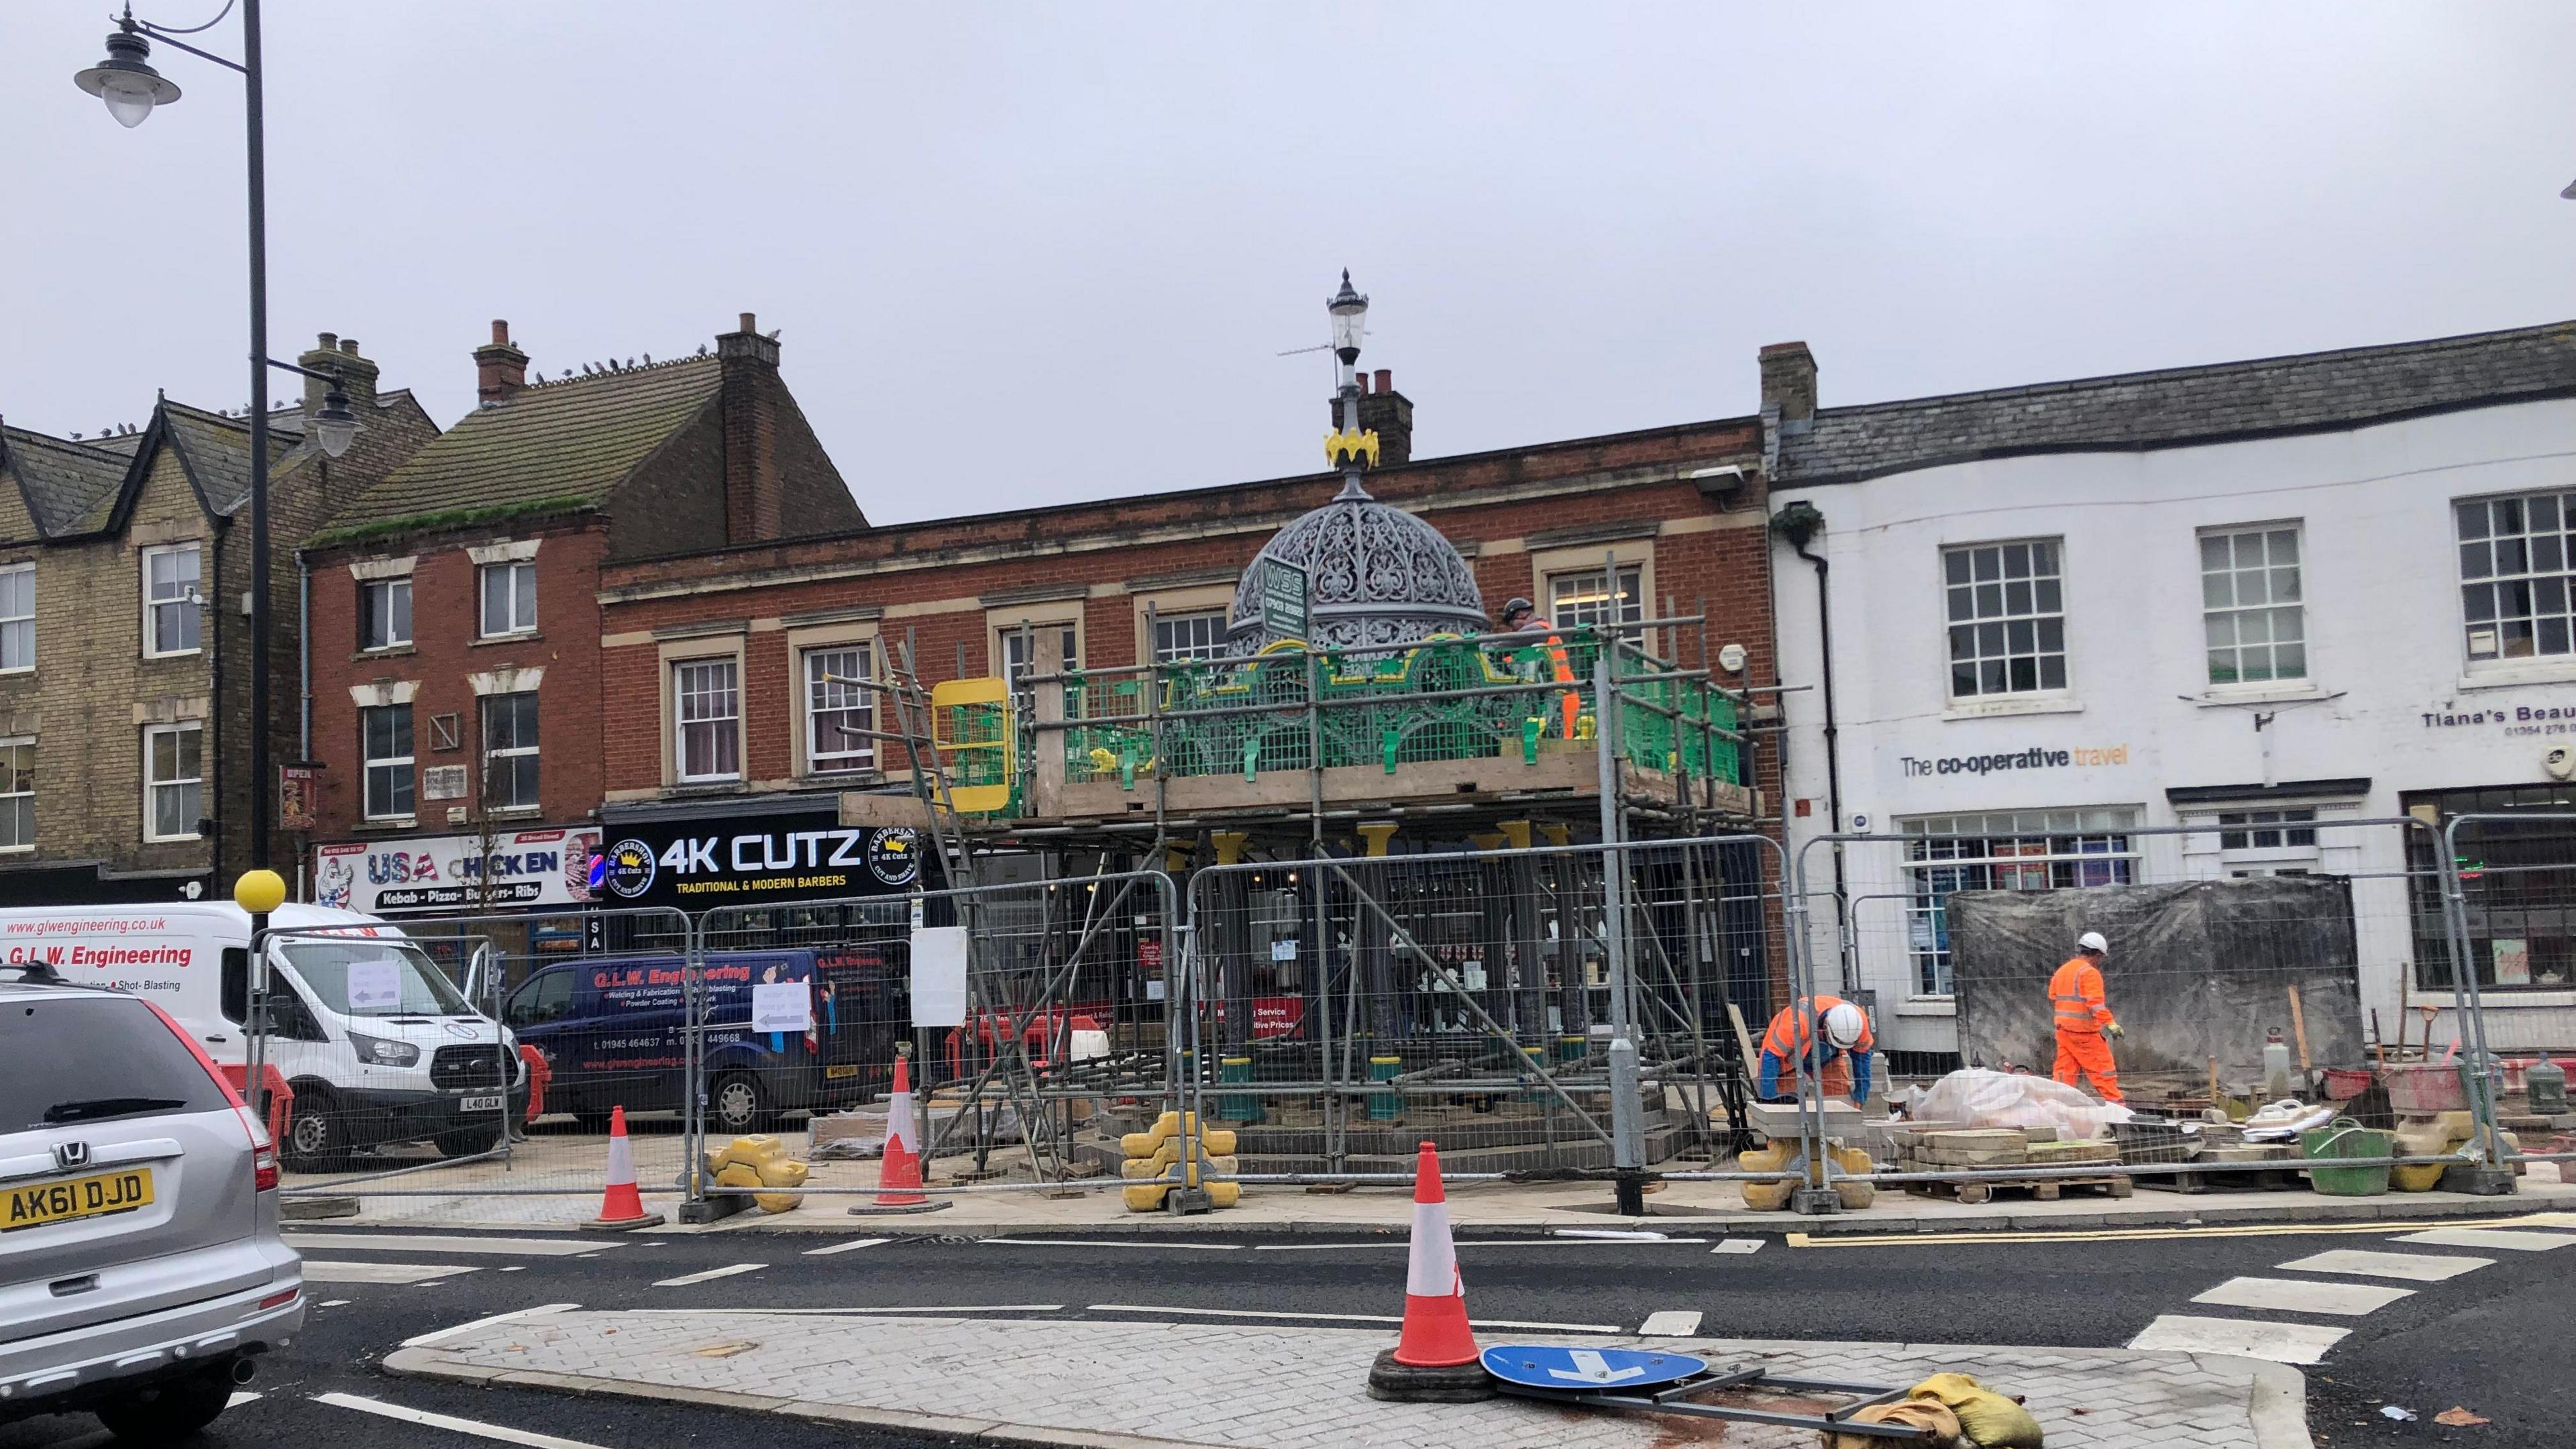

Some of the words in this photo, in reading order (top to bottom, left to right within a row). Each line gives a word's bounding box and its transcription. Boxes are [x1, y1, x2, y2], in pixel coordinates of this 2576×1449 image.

[1264, 561, 1303, 596] WSS
[2421, 710, 2506, 727] Tiana's
[1900, 757, 1933, 777] The
[1937, 747, 2070, 775] co-operative
[2074, 743, 2129, 766] travel
[871, 827, 911, 852] BARBERSH
[608, 843, 650, 867] BARBERSHOP
[659, 838, 719, 874] 4K
[731, 829, 861, 871] CUTZ
[368, 851, 439, 885] USA
[447, 851, 557, 877] CHCKEN
[875, 865, 885, 877] CUT
[676, 881, 740, 894] TRADITIONAL
[743, 881, 750, 891] &
[752, 879, 795, 890] MODERN
[798, 875, 846, 888] BARBERS
[383, 892, 418, 904] Kebab
[428, 890, 462, 902] Pizza-
[515, 885, 539, 897] Ribs
[7, 917, 166, 936] www.glwengineering.co.uk
[9, 947, 66, 965] G.LW.
[71, 945, 192, 968] Engineering
[118, 980, 142, 990] Shot-
[144, 980, 180, 991] Blasting
[594, 971, 644, 987] G.L.W.
[648, 965, 750, 984] Engiering
[608, 990, 635, 999] Welding
[643, 987, 680, 997] Fabrication
[708, 984, 736, 993] blasting
[626, 998, 651, 1007] Powder
[652, 997, 678, 1006] Coating
[601, 1040, 627, 1049] 01945
[629, 1038, 660, 1047] 464637
[707, 1033, 740, 1043] 449668
[466, 1099, 483, 1109] L40
[10, 1185, 77, 1222] AK61
[85, 1175, 142, 1208] DJD
